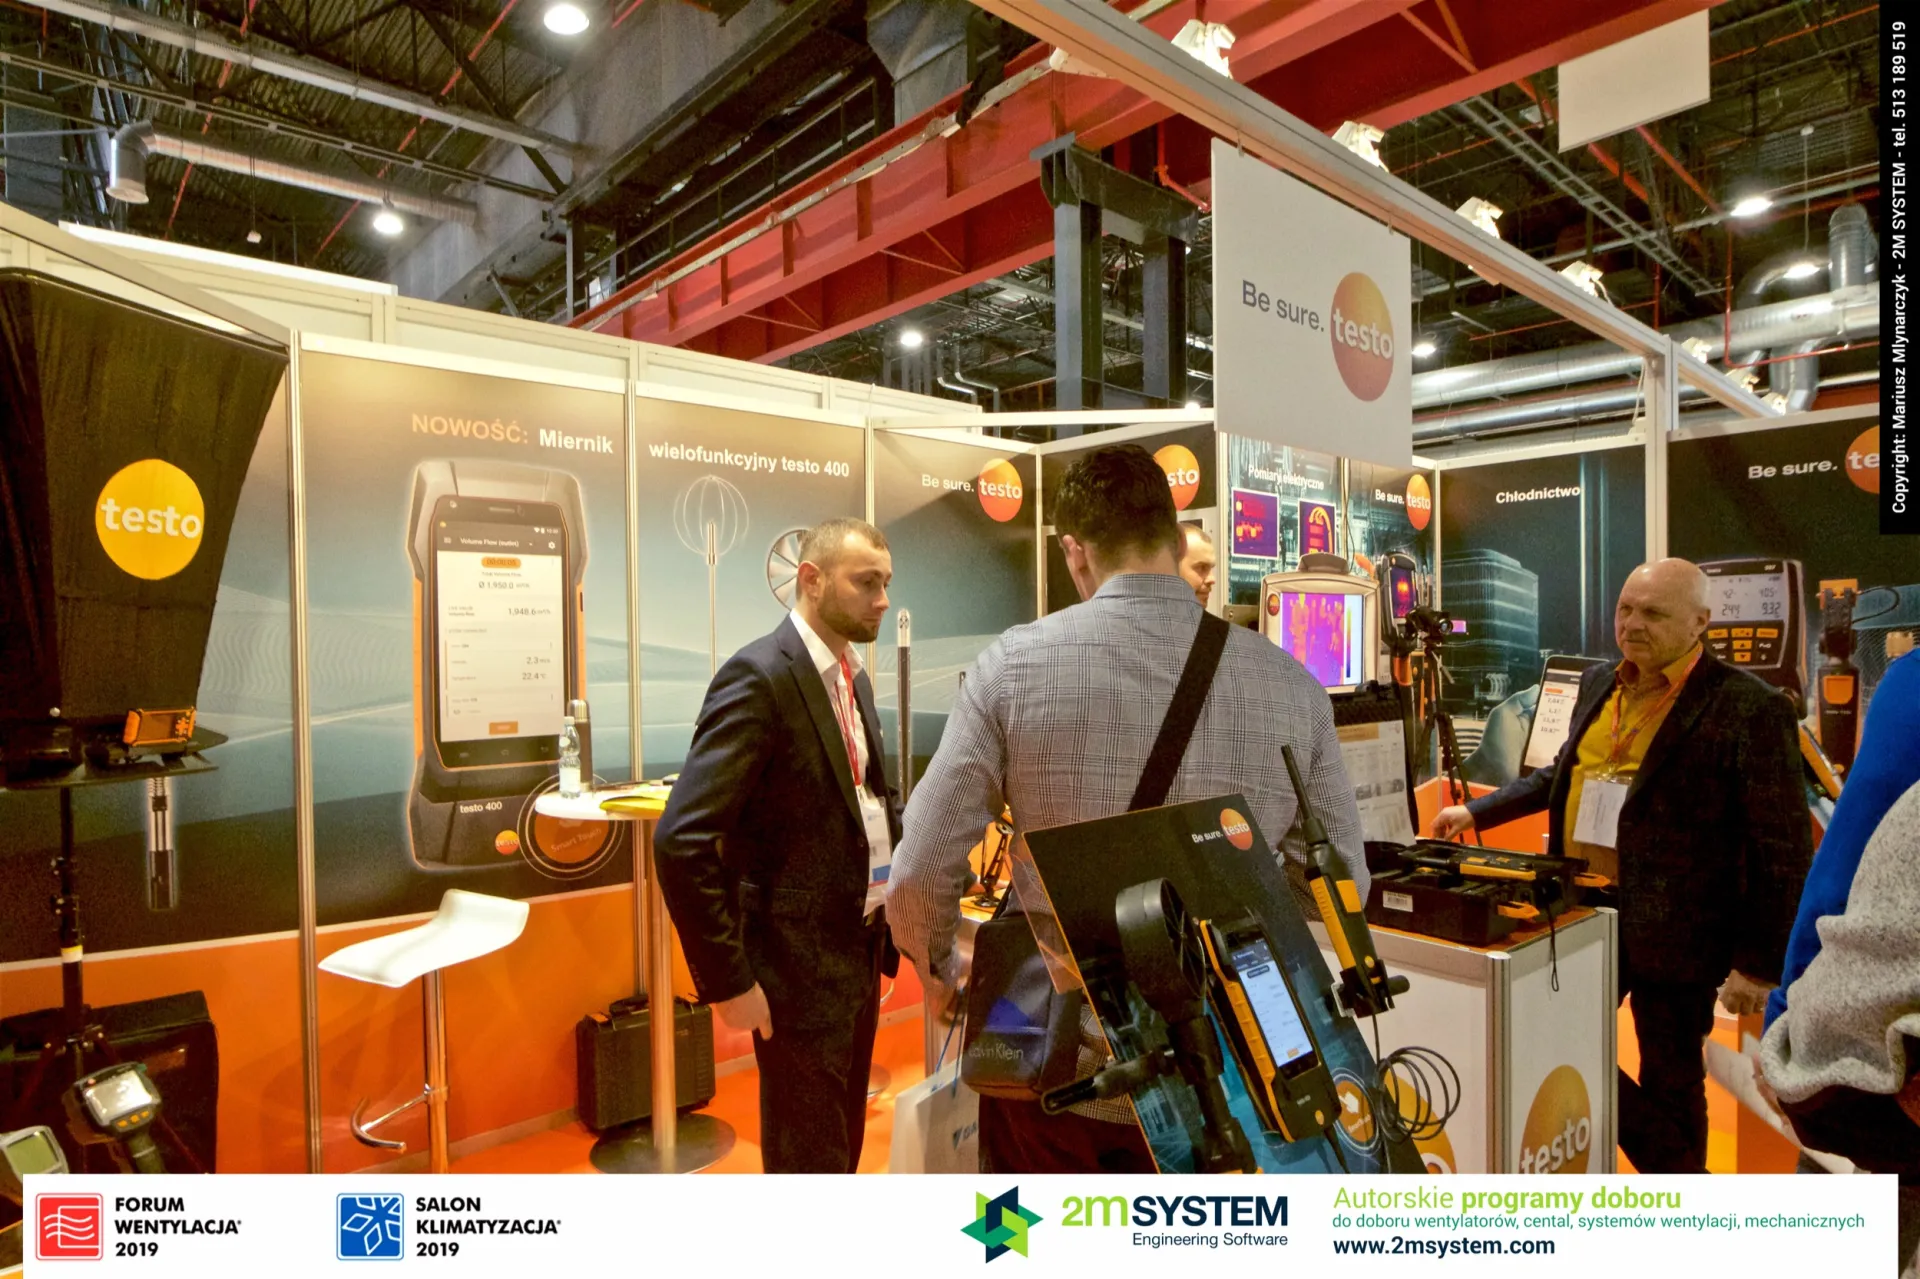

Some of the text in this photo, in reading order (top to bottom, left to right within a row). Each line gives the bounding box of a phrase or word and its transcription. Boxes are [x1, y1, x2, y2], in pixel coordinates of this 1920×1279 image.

[1242, 279, 1394, 360] Be sure. testo
[411, 413, 613, 454] NOWOŚĆ: Miernik
[649, 442, 850, 477] wielofunkcyjny testo 400
[1748, 465, 1777, 480] Be
[1781, 459, 1838, 476] sure.
[921, 474, 1022, 500] Be sure. testo
[1166, 468, 1199, 488] sto
[1248, 463, 1325, 491] Pomiary elektryczne
[1375, 488, 1431, 511] Be sure. testo
[1495, 485, 1581, 504] Chłodnictwo
[100, 496, 202, 540] testo
[459, 800, 503, 814] testo 400
[550, 826, 601, 854] Smart Touch
[1191, 822, 1250, 844] Be sure. testo
[995, 1042, 1024, 1061] Klein
[1521, 1116, 1591, 1174] testo
